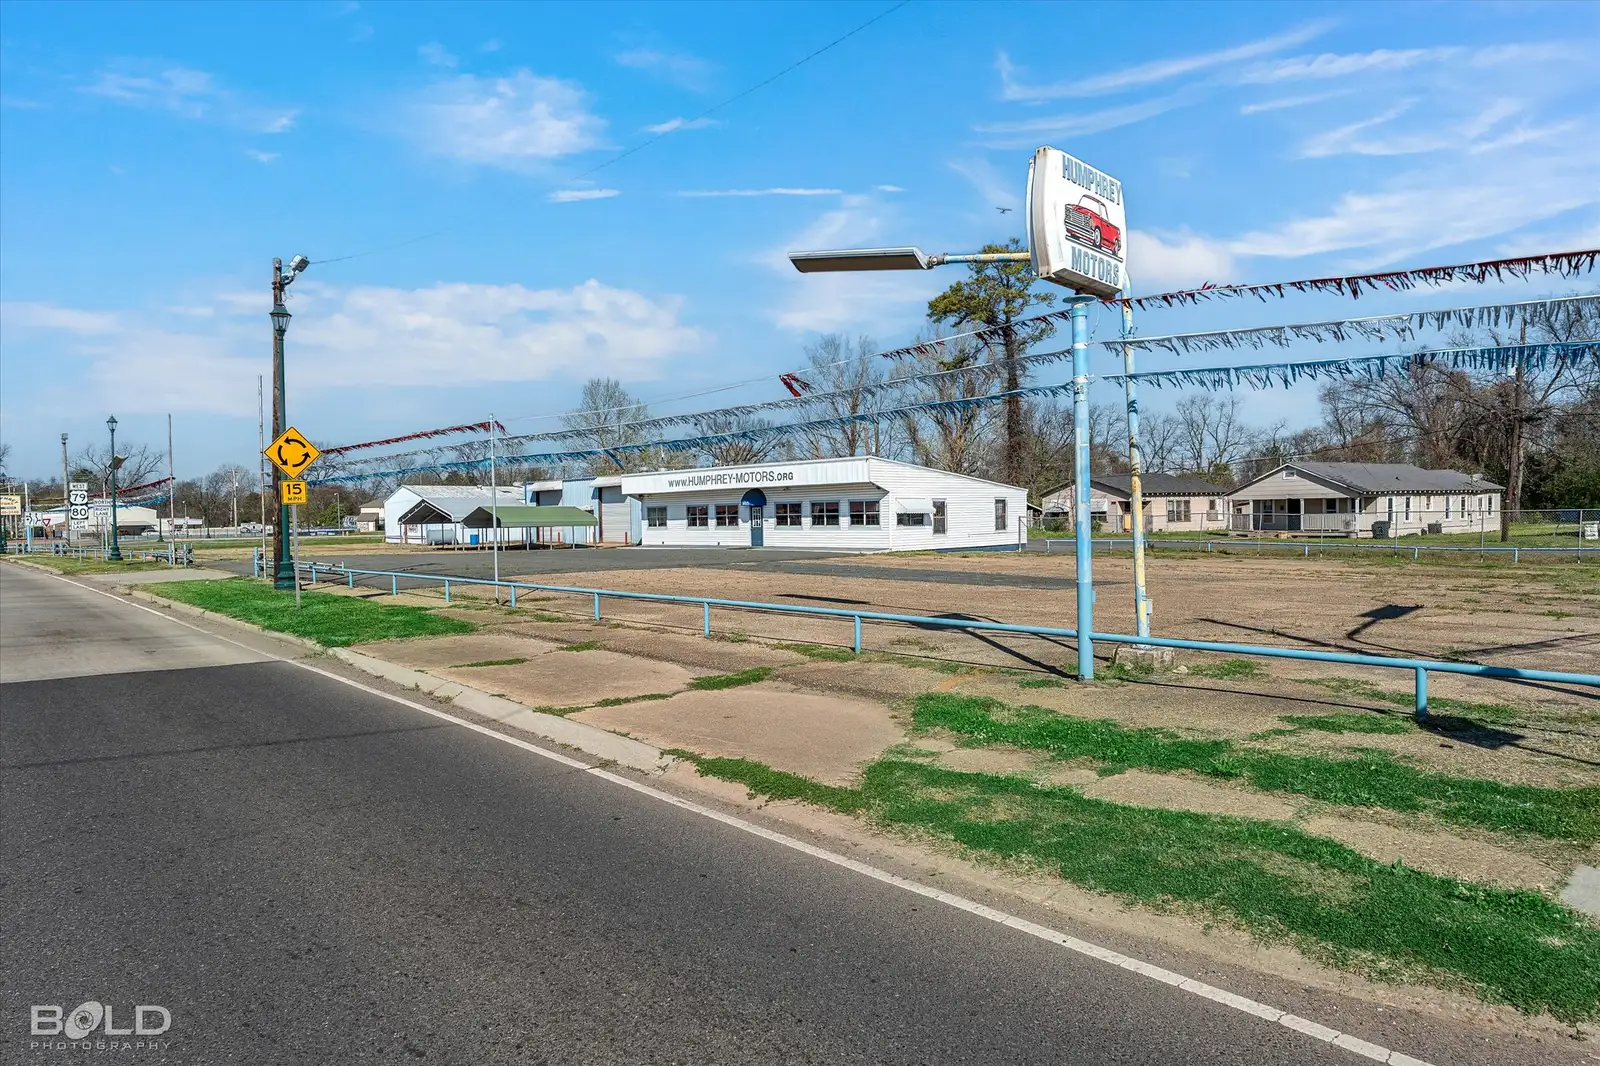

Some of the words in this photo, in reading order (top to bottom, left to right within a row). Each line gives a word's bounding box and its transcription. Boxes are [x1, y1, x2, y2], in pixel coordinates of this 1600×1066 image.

[1062, 154, 1123, 206] HUMPHREY
[1071, 246, 1120, 287] MOTORS
[286, 483, 302, 495] 15
[71, 493, 86, 502] 79
[72, 508, 87, 517] 80
